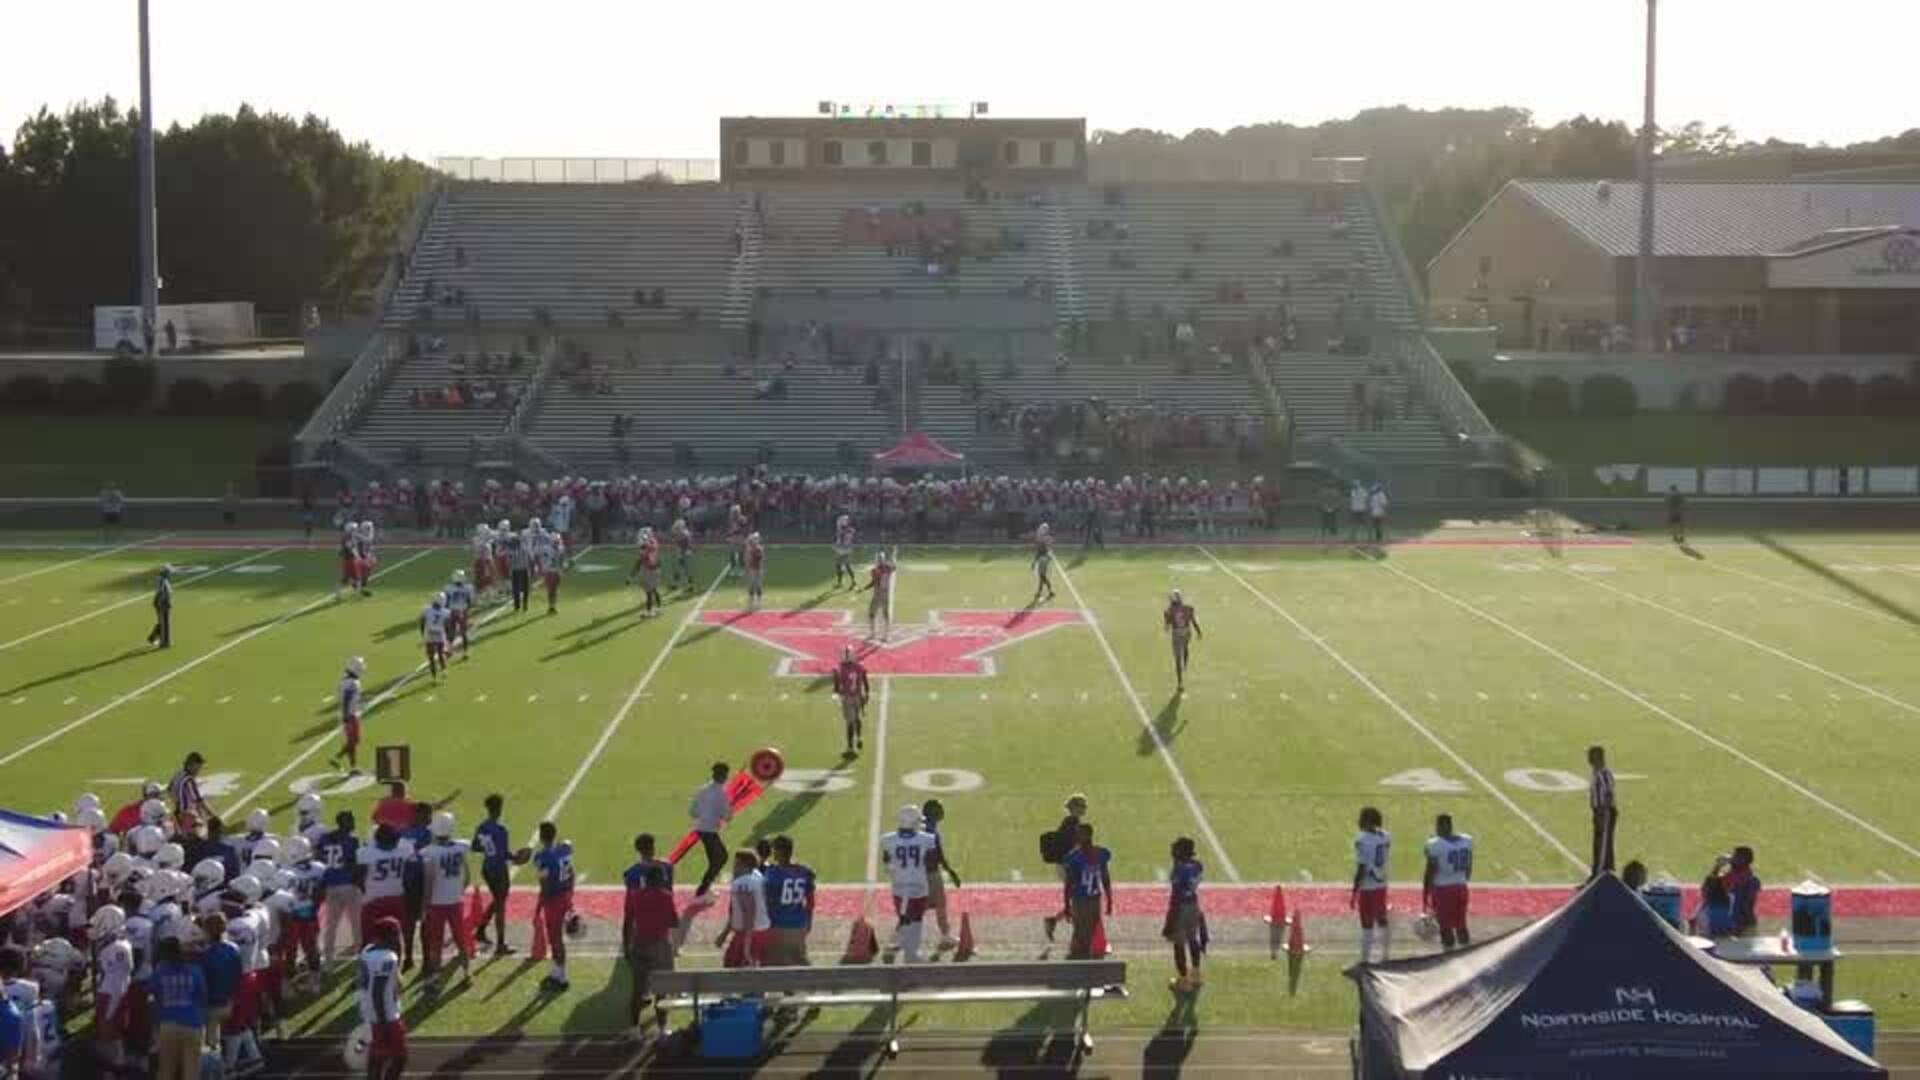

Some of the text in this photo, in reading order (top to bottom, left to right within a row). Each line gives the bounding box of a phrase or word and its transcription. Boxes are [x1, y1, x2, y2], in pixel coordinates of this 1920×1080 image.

[896, 845, 921, 869] 99
[374, 858, 402, 881] 54
[781, 877, 807, 906] 65
[1521, 1007, 1761, 1029] NORTHSIDE HOSPITAL
